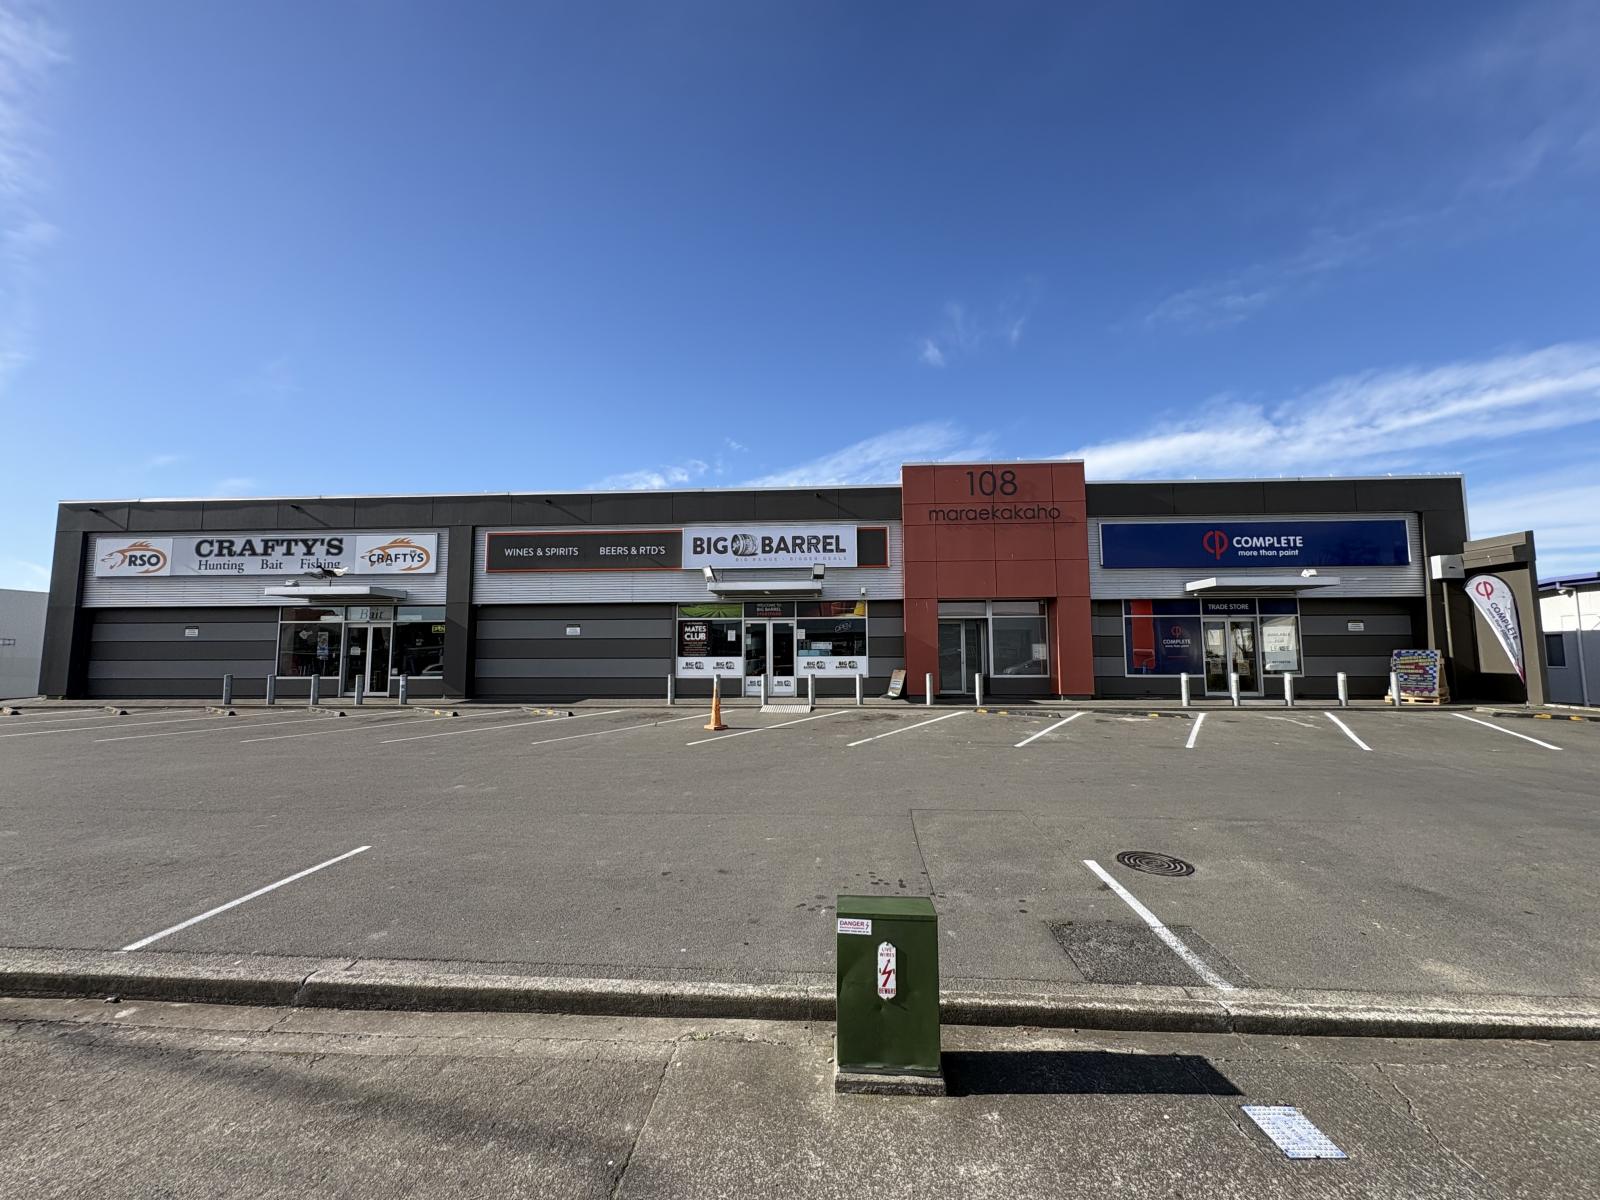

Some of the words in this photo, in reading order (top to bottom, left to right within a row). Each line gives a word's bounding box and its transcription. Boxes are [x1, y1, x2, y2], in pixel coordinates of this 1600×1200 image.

[966, 470, 1017, 496] 108
[928, 504, 1060, 520] maraekakaho
[195, 537, 344, 558] CRAFTY'S
[692, 537, 729, 555] BIG
[761, 535, 846, 554] BARREL
[1232, 536, 1304, 548] COMPLETE
[504, 548, 534, 556] WINES
[536, 548, 543, 556] &
[545, 547, 579, 556] SPIRITS
[600, 547, 629, 555] BEERS
[631, 547, 638, 555] &
[640, 546, 666, 555] RTD'S
[1279, 548, 1299, 557] paint
[128, 554, 161, 567] RSO
[368, 552, 424, 563] CRAFTYS
[198, 560, 245, 573] Hunting
[260, 559, 283, 570] Bait
[300, 558, 341, 571] Fishing
[360, 608, 384, 619] Bait
[1490, 602, 1520, 640] COMPLETE
